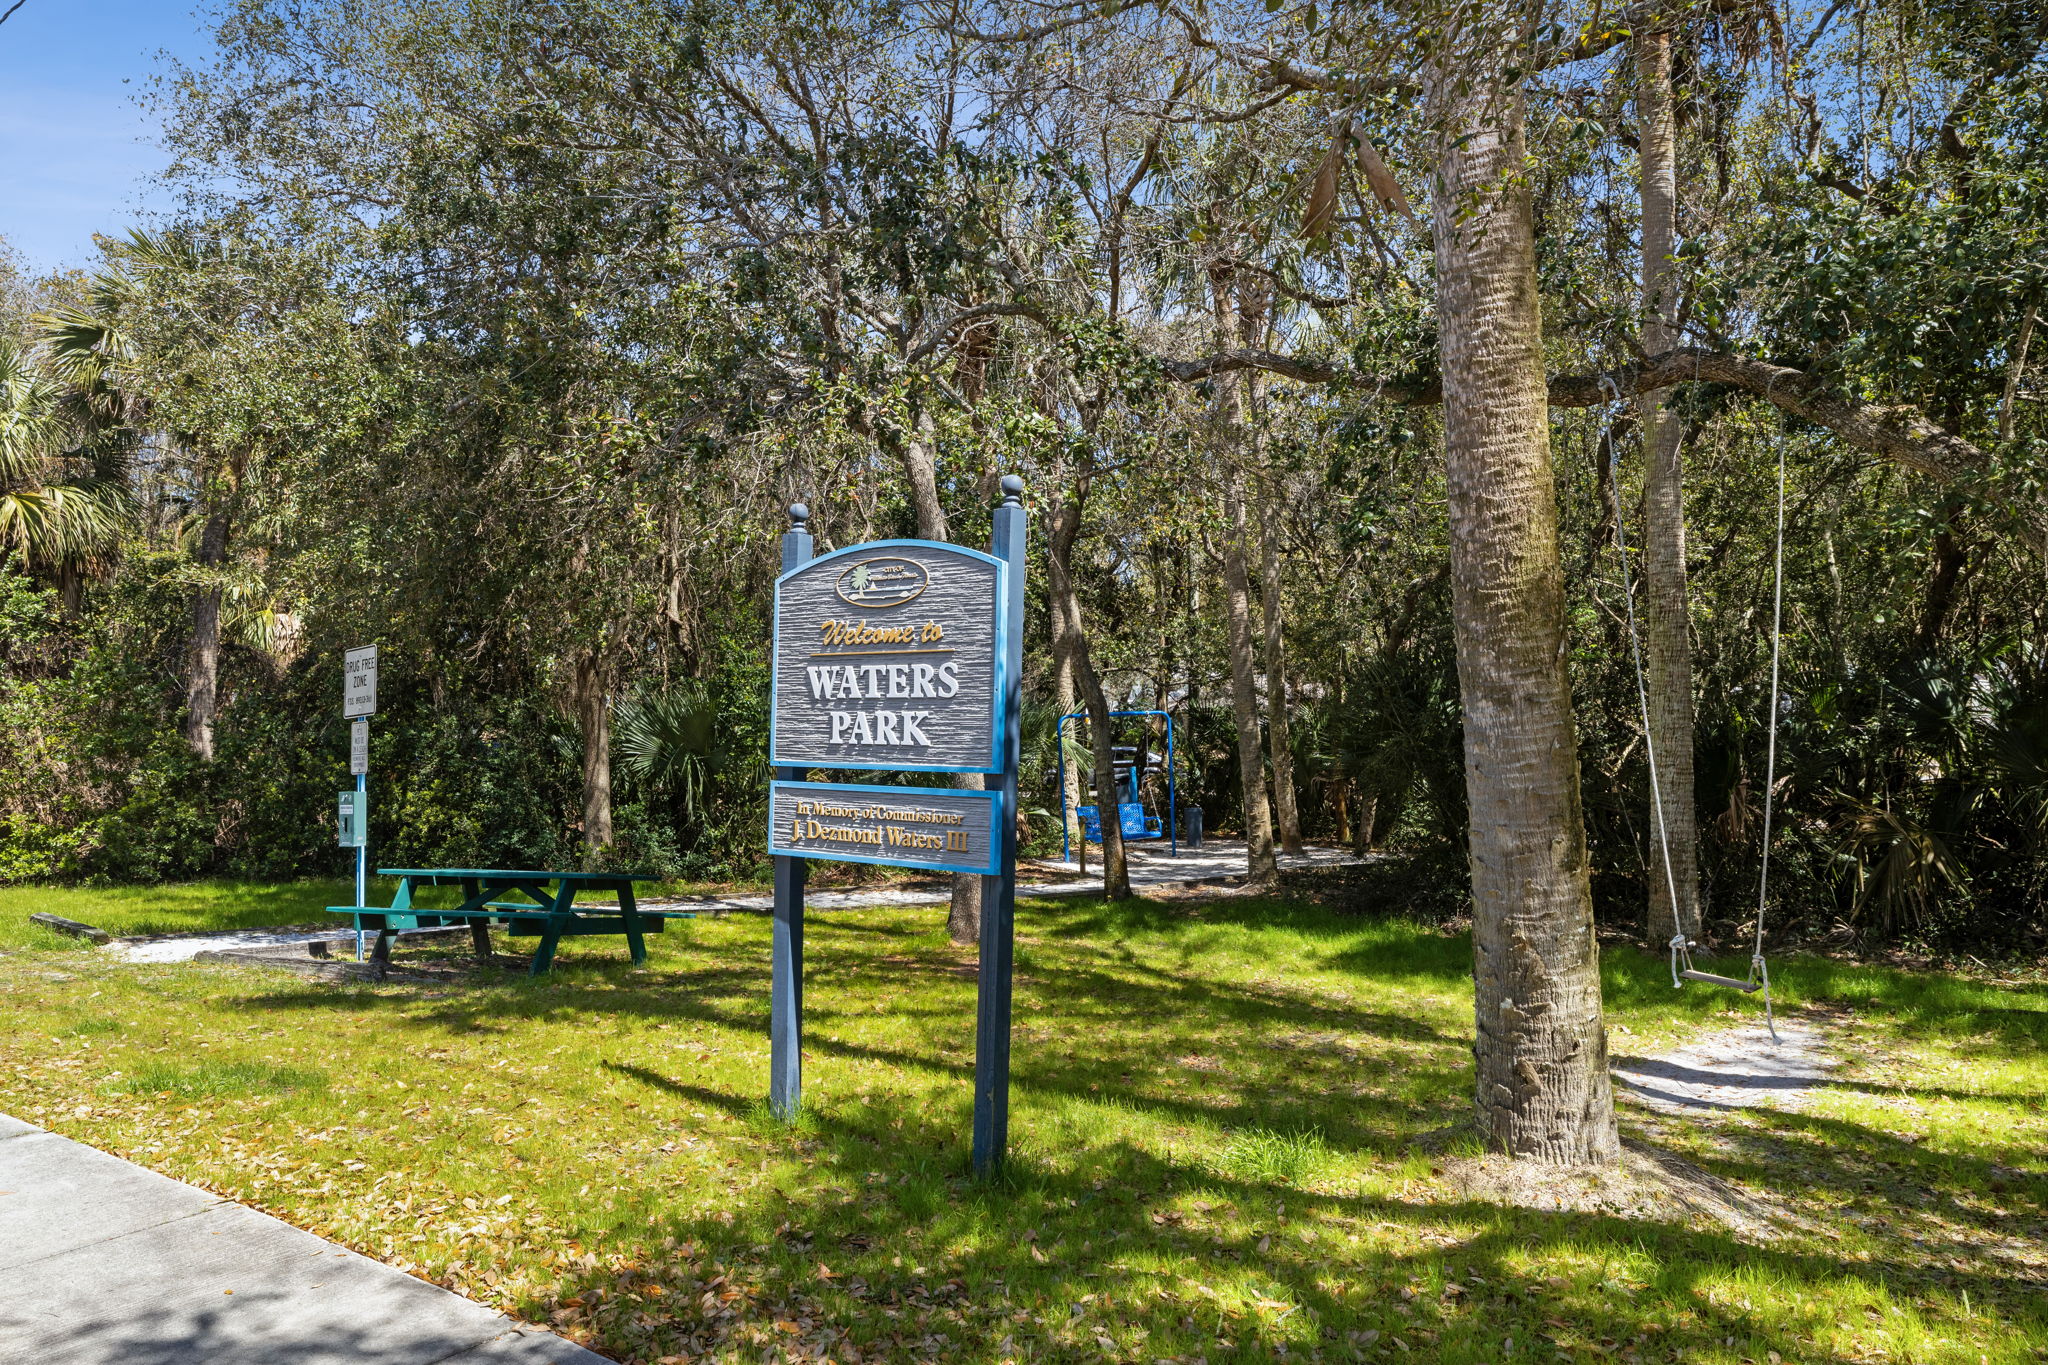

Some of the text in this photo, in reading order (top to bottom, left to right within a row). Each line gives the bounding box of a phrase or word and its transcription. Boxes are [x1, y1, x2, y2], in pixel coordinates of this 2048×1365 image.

[821, 618, 943, 646] Welcome to
[346, 656, 375, 673] DRUG FREE
[353, 674, 367, 688] ZONE
[806, 661, 960, 699] WATERS
[829, 709, 932, 746] PARK
[796, 800, 964, 825] In Memory of Commissioner
[806, 820, 882, 845] Dezmond
[886, 825, 942, 849] Waters
[946, 830, 968, 851] III
